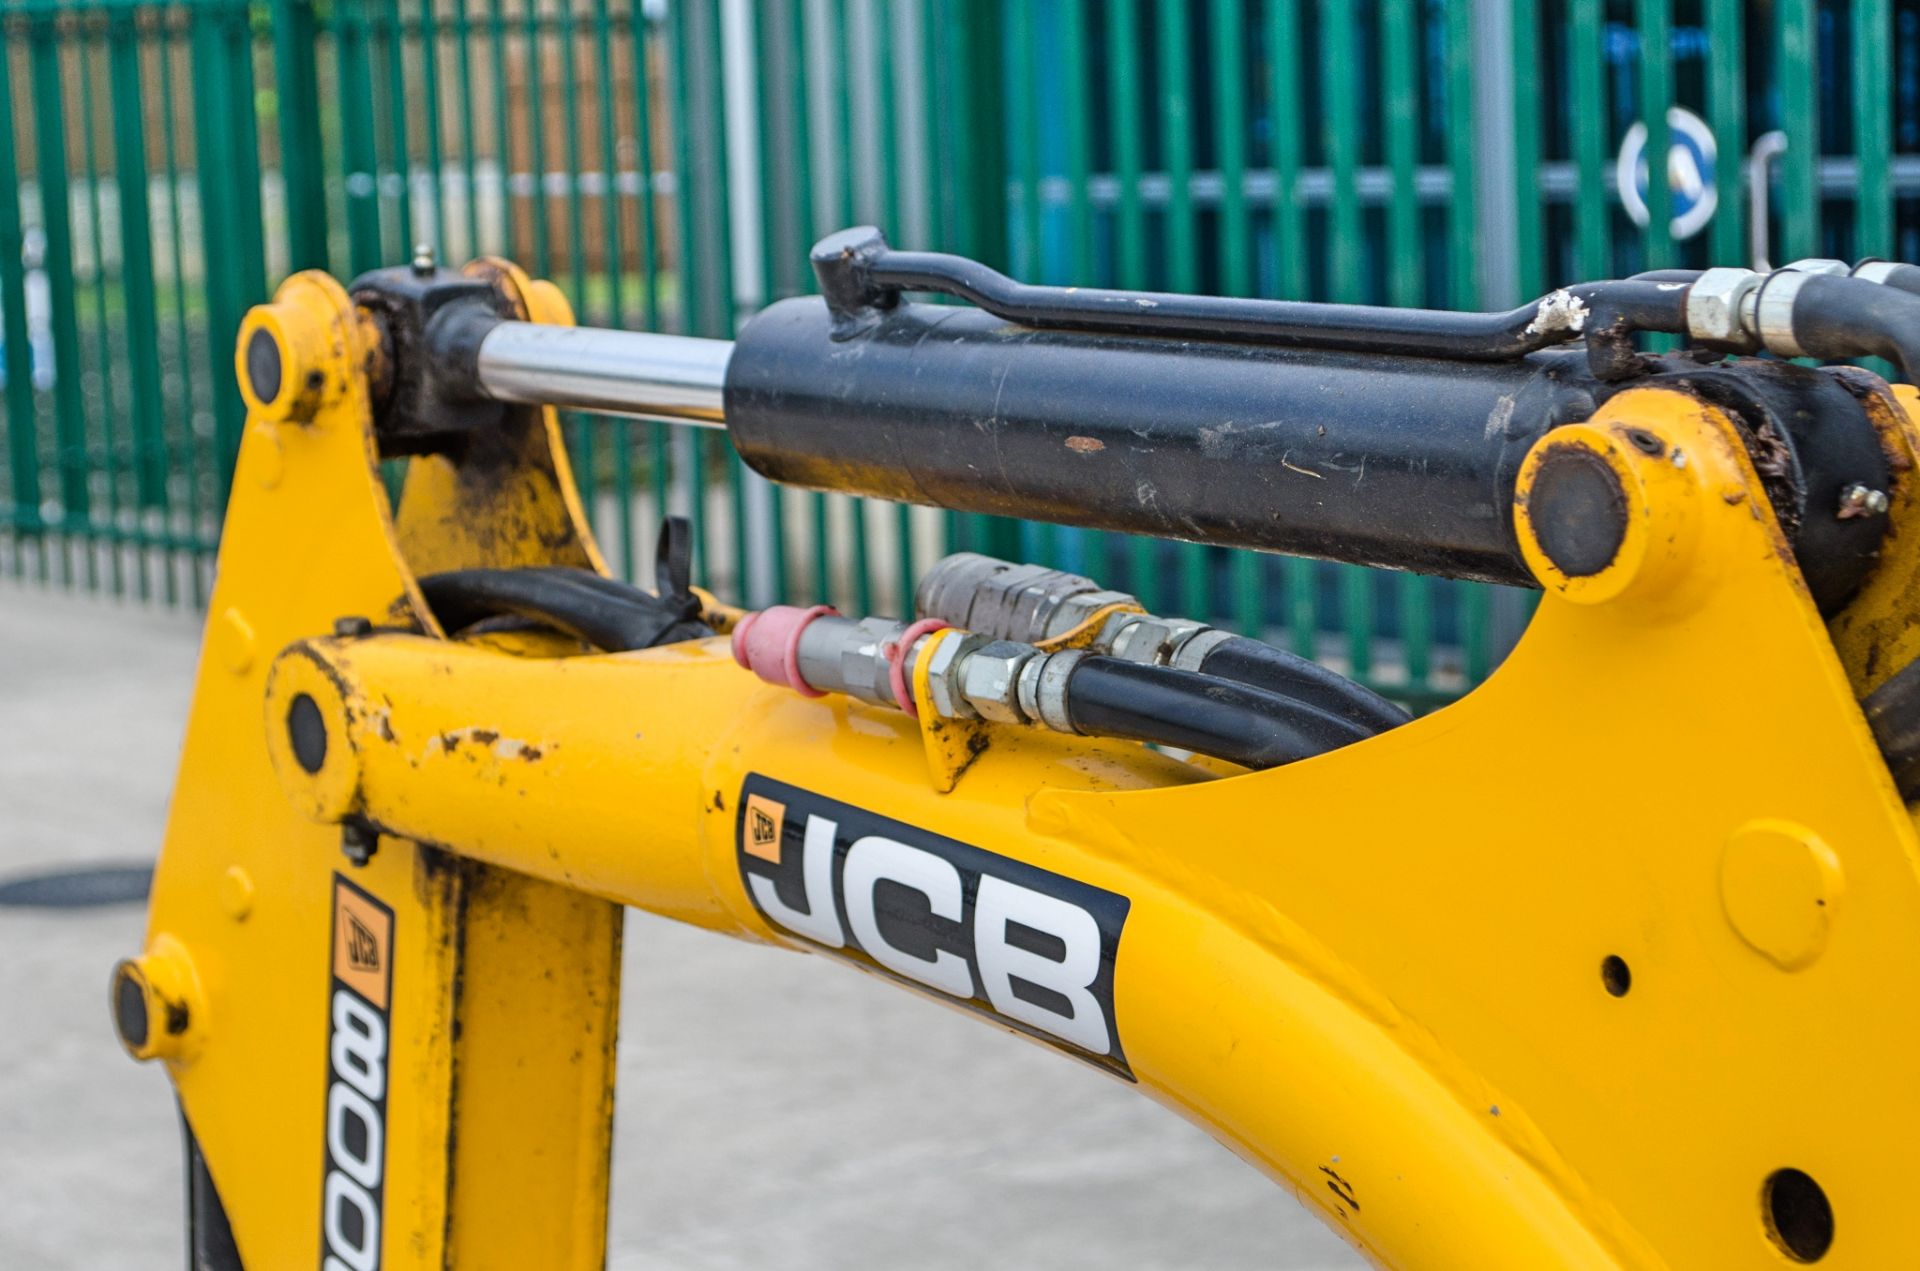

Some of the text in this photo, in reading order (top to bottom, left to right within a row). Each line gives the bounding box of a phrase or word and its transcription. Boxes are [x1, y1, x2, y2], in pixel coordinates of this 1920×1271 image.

[754, 813, 774, 841] JCB
[347, 918, 378, 967] JCB
[747, 813, 1111, 1056] JCB
[324, 989, 387, 1271] 800
